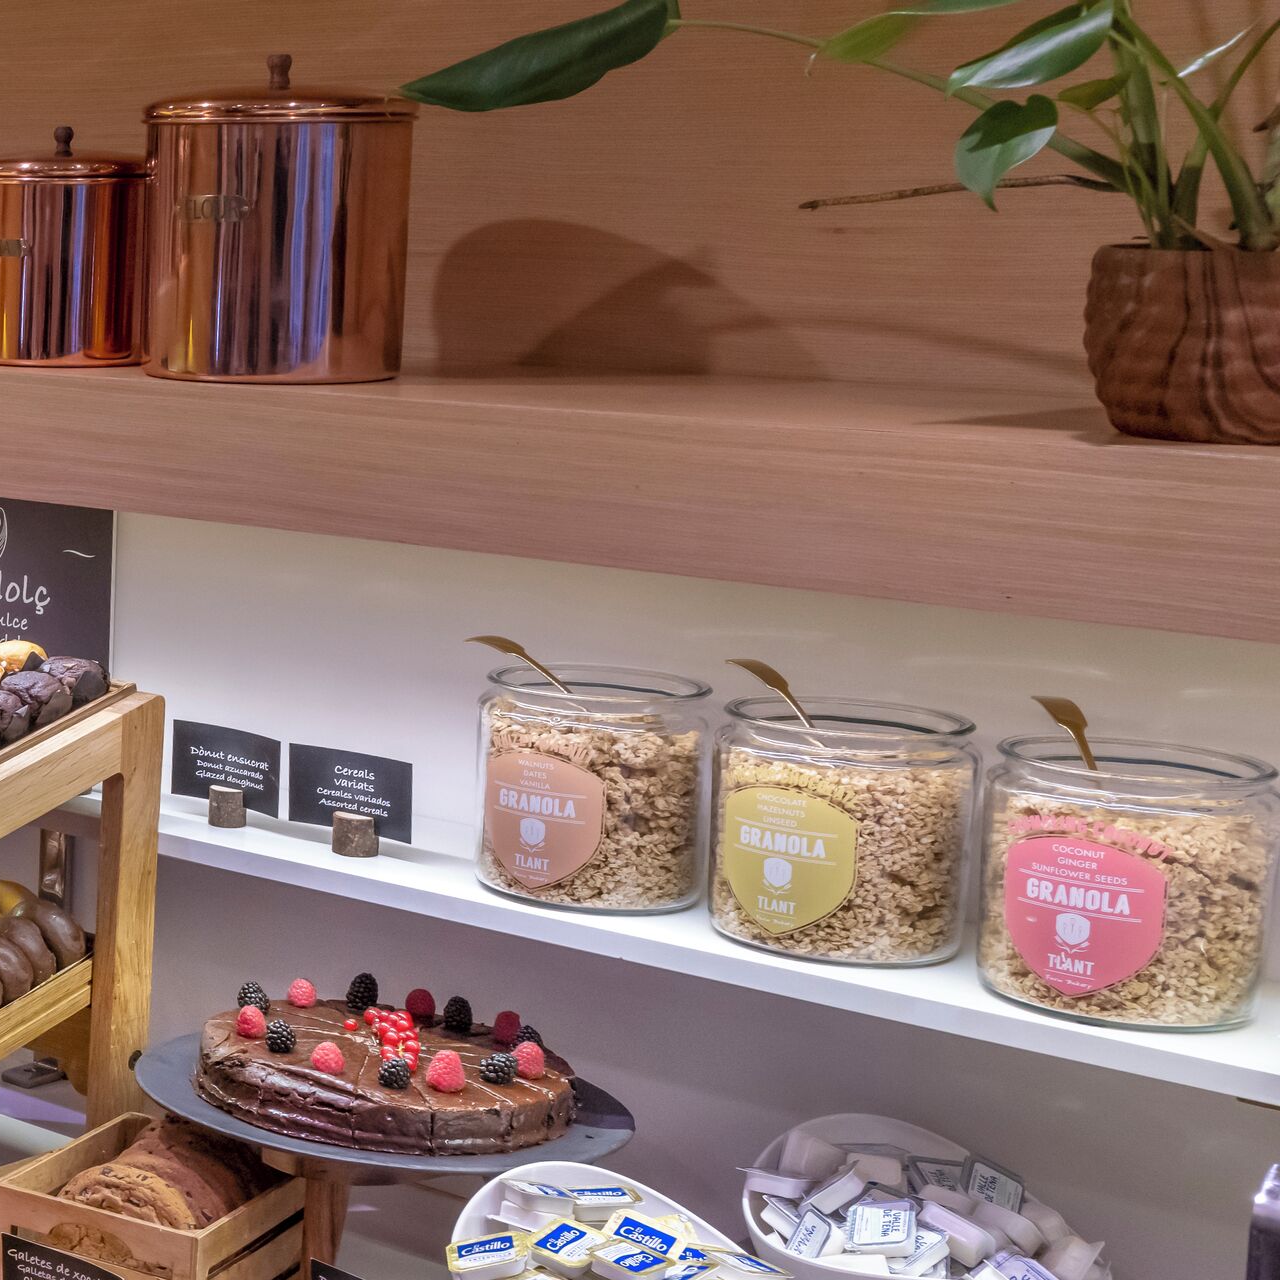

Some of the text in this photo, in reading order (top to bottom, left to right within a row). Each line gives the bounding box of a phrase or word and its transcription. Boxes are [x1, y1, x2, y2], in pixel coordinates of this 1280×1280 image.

[196, 759, 264, 781] Donut azucarado
[226, 753, 270, 771] ensucrat
[518, 758, 555, 770] WALNUTS
[195, 769, 264, 791] Glazed doughnut
[334, 765, 376, 781] Cereals
[523, 771, 548, 780] DATES
[333, 778, 375, 793] variats
[519, 779, 551, 790] VANILLA
[316, 786, 392, 808] Cereales variados
[499, 787, 577, 819] GRANOLA
[756, 792, 807, 808] CHOCOLATE
[318, 797, 389, 818] Assorted cereals
[756, 803, 806, 818] HAZELNUTS
[739, 824, 827, 859] GRANOLA
[1051, 843, 1105, 859] COCONUT
[514, 852, 551, 872] TLANT
[1057, 856, 1098, 870] GINGER
[1031, 861, 1128, 886] SUNFLOWER SEEDS
[756, 894, 797, 915] TLANT
[1026, 876, 1131, 916] GRANOLA
[1047, 952, 1096, 976] TLANT
[573, 1189, 623, 1197] Castillo
[881, 1219, 893, 1238] TENA
[890, 1211, 902, 1233] VALLE
[460, 1240, 511, 1257] Castillo
[546, 1229, 581, 1252] Castillo
[619, 1225, 668, 1252] Castillo
[7, 1248, 53, 1270] Galetes
[56, 1263, 71, 1277] de
